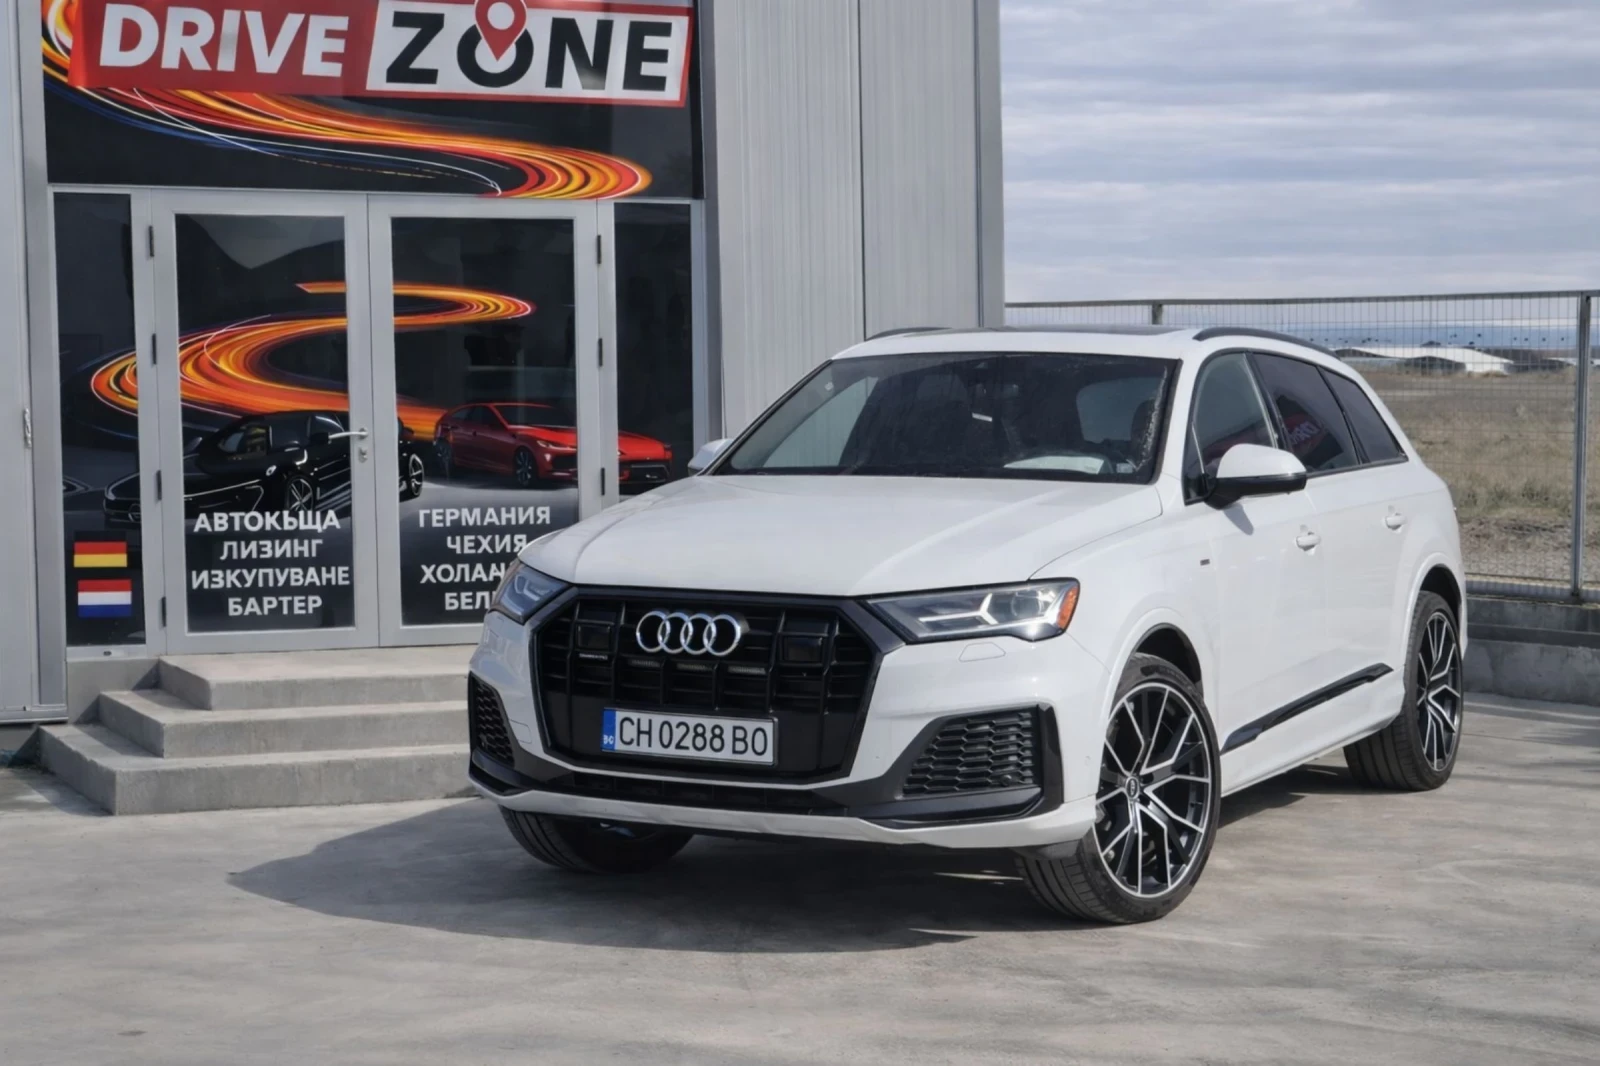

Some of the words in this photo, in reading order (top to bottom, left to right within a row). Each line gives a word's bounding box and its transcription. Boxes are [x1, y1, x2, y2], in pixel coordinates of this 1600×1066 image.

[99, 3, 349, 78] DRIVE
[385, 10, 672, 92] ZONE
[418, 506, 551, 528] ГЕРМАНИЯ
[219, 539, 323, 561] ЛИЗИНГ
[446, 534, 528, 554] ЧЕХИЯ
[191, 566, 350, 590] ИЗКУПУВАНЕ
[420, 563, 506, 584] ХОЛАН
[228, 596, 323, 617] БАРТЕР
[444, 590, 496, 611] БЕЛ
[619, 716, 652, 747] CH
[659, 720, 724, 752] 0288
[732, 725, 768, 756] BO
